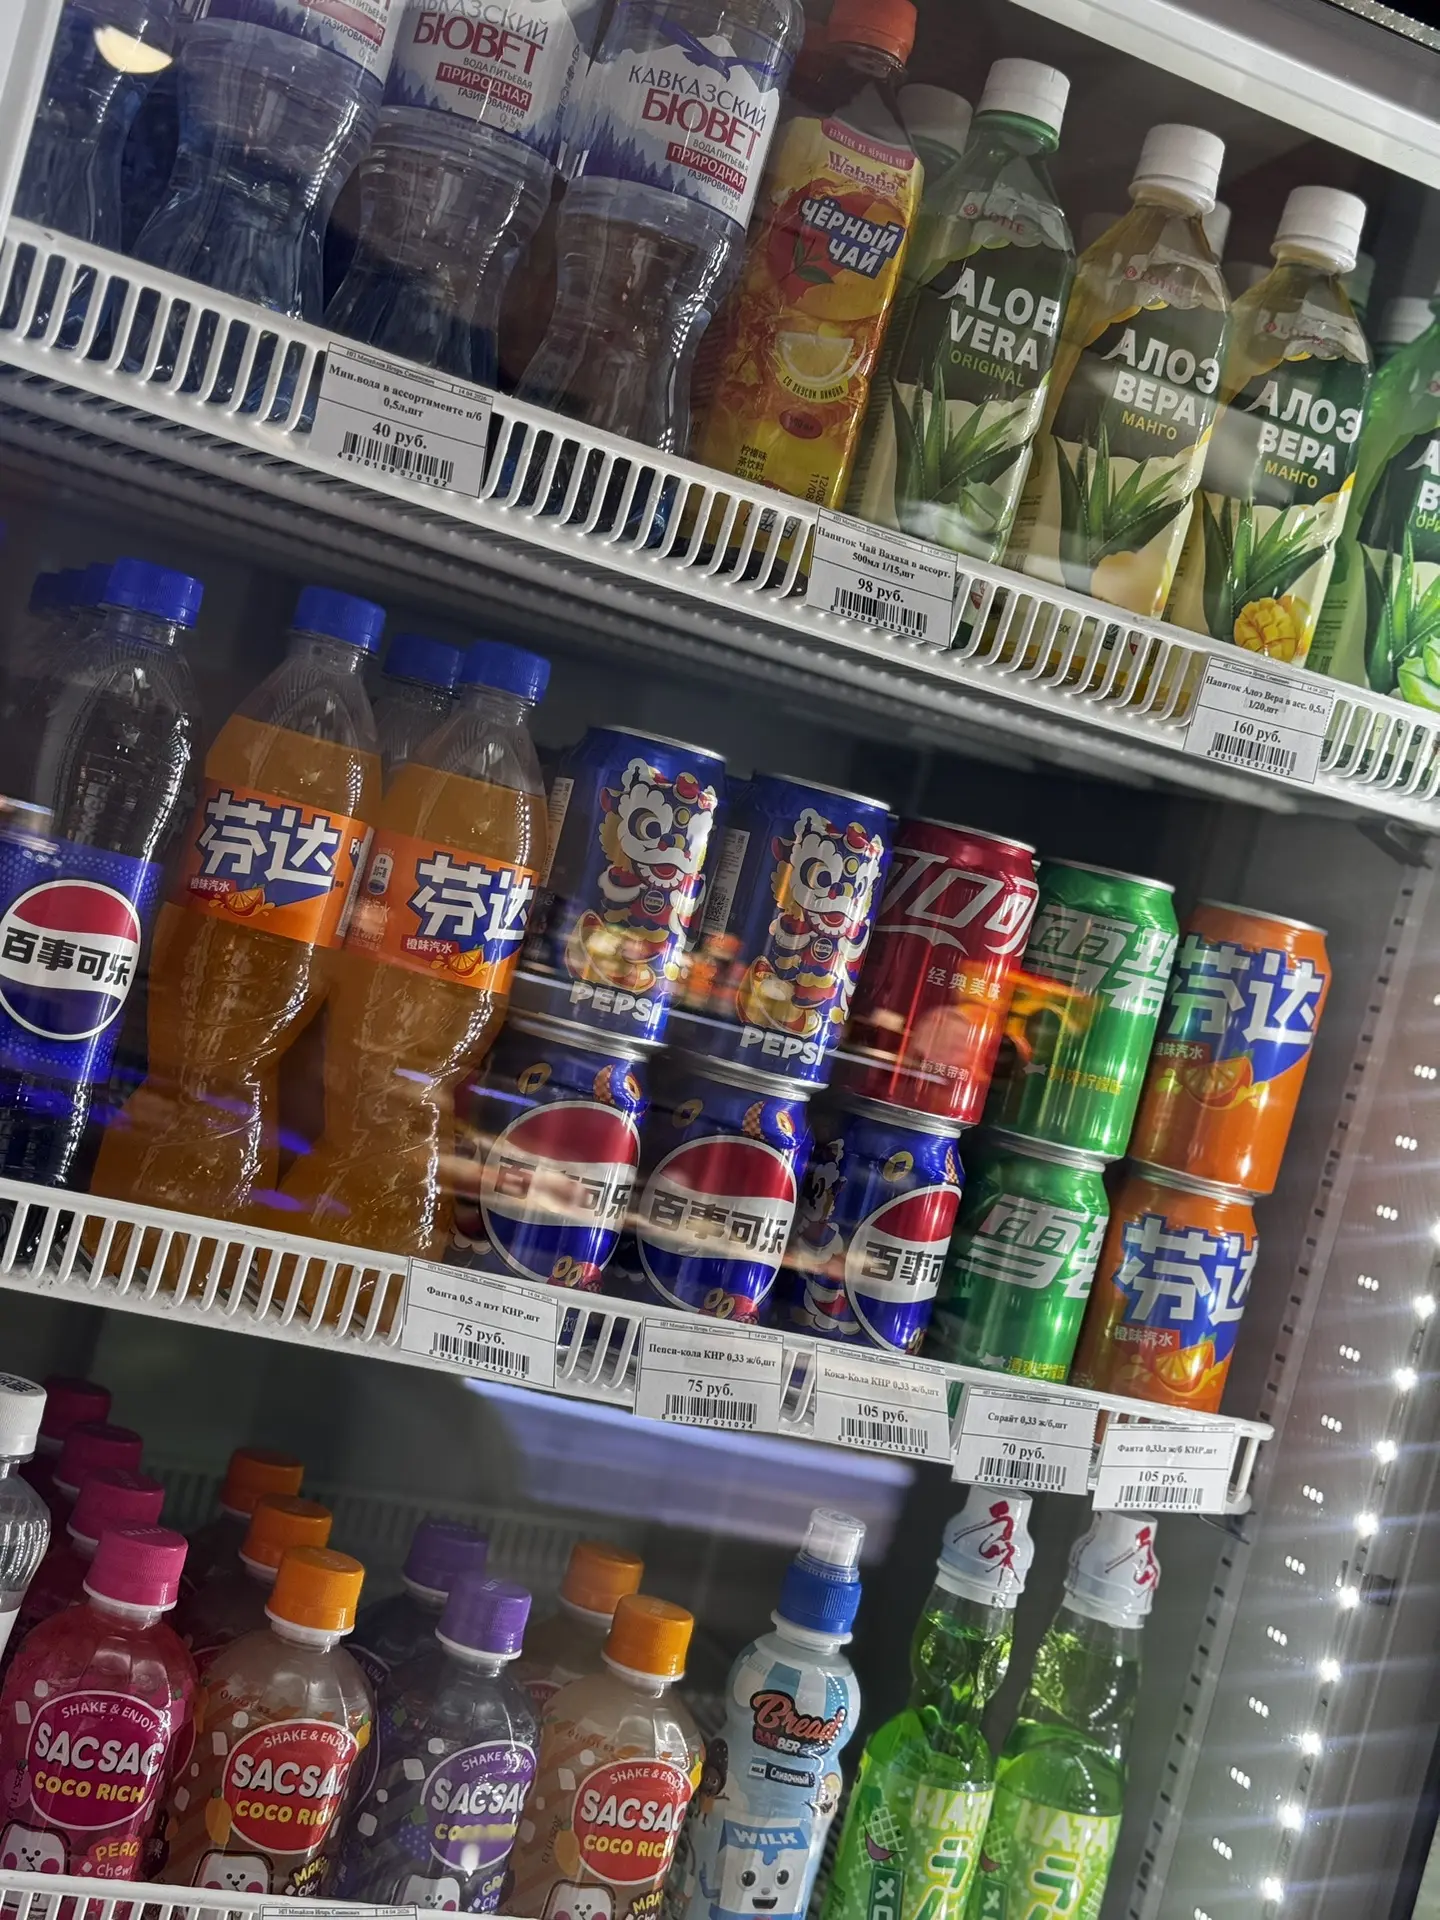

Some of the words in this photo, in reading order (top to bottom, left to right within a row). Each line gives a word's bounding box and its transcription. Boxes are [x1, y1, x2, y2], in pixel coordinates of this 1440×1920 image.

[413, 12, 543, 75] БЮВЕТ
[441, 65, 529, 107] ПРИРОДНАЯ
[489, 62, 533, 90] ПИТЬЕВАЯ
[457, 87, 525, 119] ГАЗИРОВАННАЯ
[629, 65, 766, 130] КАВКАЗСКИЙ
[642, 88, 761, 160] БЮВЕТ
[693, 139, 716, 155] ВОДА
[671, 145, 745, 188] ПРИРОДНАЯ
[688, 170, 742, 202] ГАЗИРОВАННАЯ
[801, 199, 899, 252] ЧЁРНЫЙ
[829, 238, 881, 273] ЧАЙ
[938, 267, 1060, 337] ALOE
[949, 308, 1038, 371] VERA
[950, 349, 1024, 388] ORIGINAL
[1100, 328, 1220, 394] АЛОЭ
[329, 363, 380, 390] Мин.вода
[382, 384, 390, 393] в
[391, 388, 463, 416] ассортименте
[465, 409, 482, 422] п/б
[383, 397, 424, 418] 0,5л,шт
[1113, 370, 1196, 426] ВЕРА
[1122, 410, 1178, 441] МАНГО
[1243, 380, 1363, 443] АЛОЭ
[372, 421, 391, 438] 40
[394, 430, 428, 450] руб.
[1255, 421, 1335, 475] ВЕРА
[737, 456, 765, 473] 茶饮料
[740, 444, 768, 461] 柠檬味
[1265, 460, 1318, 488] МАНГО
[818, 526, 857, 548] Напиток
[859, 542, 876, 556] Чай
[879, 548, 909, 566] Вахаха
[918, 564, 951, 579] ассорт.
[852, 552, 880, 568] 500мл
[882, 562, 916, 580] 1/15,шт
[858, 578, 873, 593] 98
[876, 586, 904, 603] руб.
[1205, 675, 1242, 693] Напиток
[1242, 686, 1263, 698] Алоэ
[1264, 692, 1284, 704] Вера
[1292, 701, 1307, 711] асс.
[1248, 699, 1280, 715] 1/20,шт
[1232, 720, 1254, 735] 160
[1256, 727, 1281, 743] руб.
[199, 790, 338, 887] 芬达
[190, 877, 230, 893] 橙味汽水
[411, 853, 534, 942] 芬达
[1, 926, 133, 987] 百事可乐
[406, 936, 453, 955] 橙味汽水
[1020, 903, 1179, 1018] 雪碧
[926, 966, 1001, 1001] 经典美味
[1167, 935, 1323, 1046] 芬达
[739, 1025, 826, 1067] PEPSI
[649, 1188, 788, 1255] 百事可乐
[1117, 1217, 1259, 1327] 芬达
[426, 1285, 457, 1301] Фанта
[459, 1294, 473, 1305] 0,5
[483, 1302, 500, 1312] пэт
[501, 1305, 541, 1323] КНР,шт
[456, 1322, 473, 1336] 75
[476, 1330, 506, 1345] руб.
[1114, 1325, 1173, 1350] 橙味汽水
[648, 1342, 702, 1358] Пепси-кола
[703, 1350, 725, 1361] КНР
[726, 1354, 745, 1364] 0,33
[746, 1356, 777, 1368] ж/б,шт
[687, 1378, 703, 1393] 75
[706, 1383, 734, 1398] руб.
[824, 1367, 869, 1385] Кока-Кола
[871, 1377, 891, 1387] КНР
[892, 1381, 910, 1391] 0,33
[911, 1384, 940, 1397] ж/б,шт
[857, 1403, 879, 1417] 105
[882, 1409, 908, 1423] руб.
[987, 1412, 1019, 1425] Спрайт
[1020, 1415, 1037, 1425] 0,33
[1038, 1418, 1068, 1430] ж/б,шт
[1002, 1443, 1016, 1455] 70
[1019, 1447, 1045, 1460] руб.
[1117, 1444, 1144, 1453] Фанта
[1139, 1471, 1159, 1483] 105
[1161, 1472, 1187, 1485] руб.
[61, 1701, 107, 1719] SHAKE
[109, 1703, 119, 1715] &
[121, 1706, 157, 1733] ENJOY
[751, 1691, 848, 1743] Bread
[34, 1721, 165, 1777] SACSAC
[263, 1729, 308, 1749] SHAKE
[309, 1731, 319, 1741] &
[461, 1750, 502, 1772] SHAKE
[610, 1768, 651, 1785] SHAKE
[651, 1768, 660, 1777] &
[770, 1766, 812, 1786] Сливочный
[34, 1771, 92, 1798] COCO
[95, 1783, 146, 1803] RICH
[236, 1800, 293, 1823] COCO
[581, 1789, 687, 1831] SACSAC
[583, 1834, 633, 1855] COCO
[733, 1828, 799, 1845] WILK
